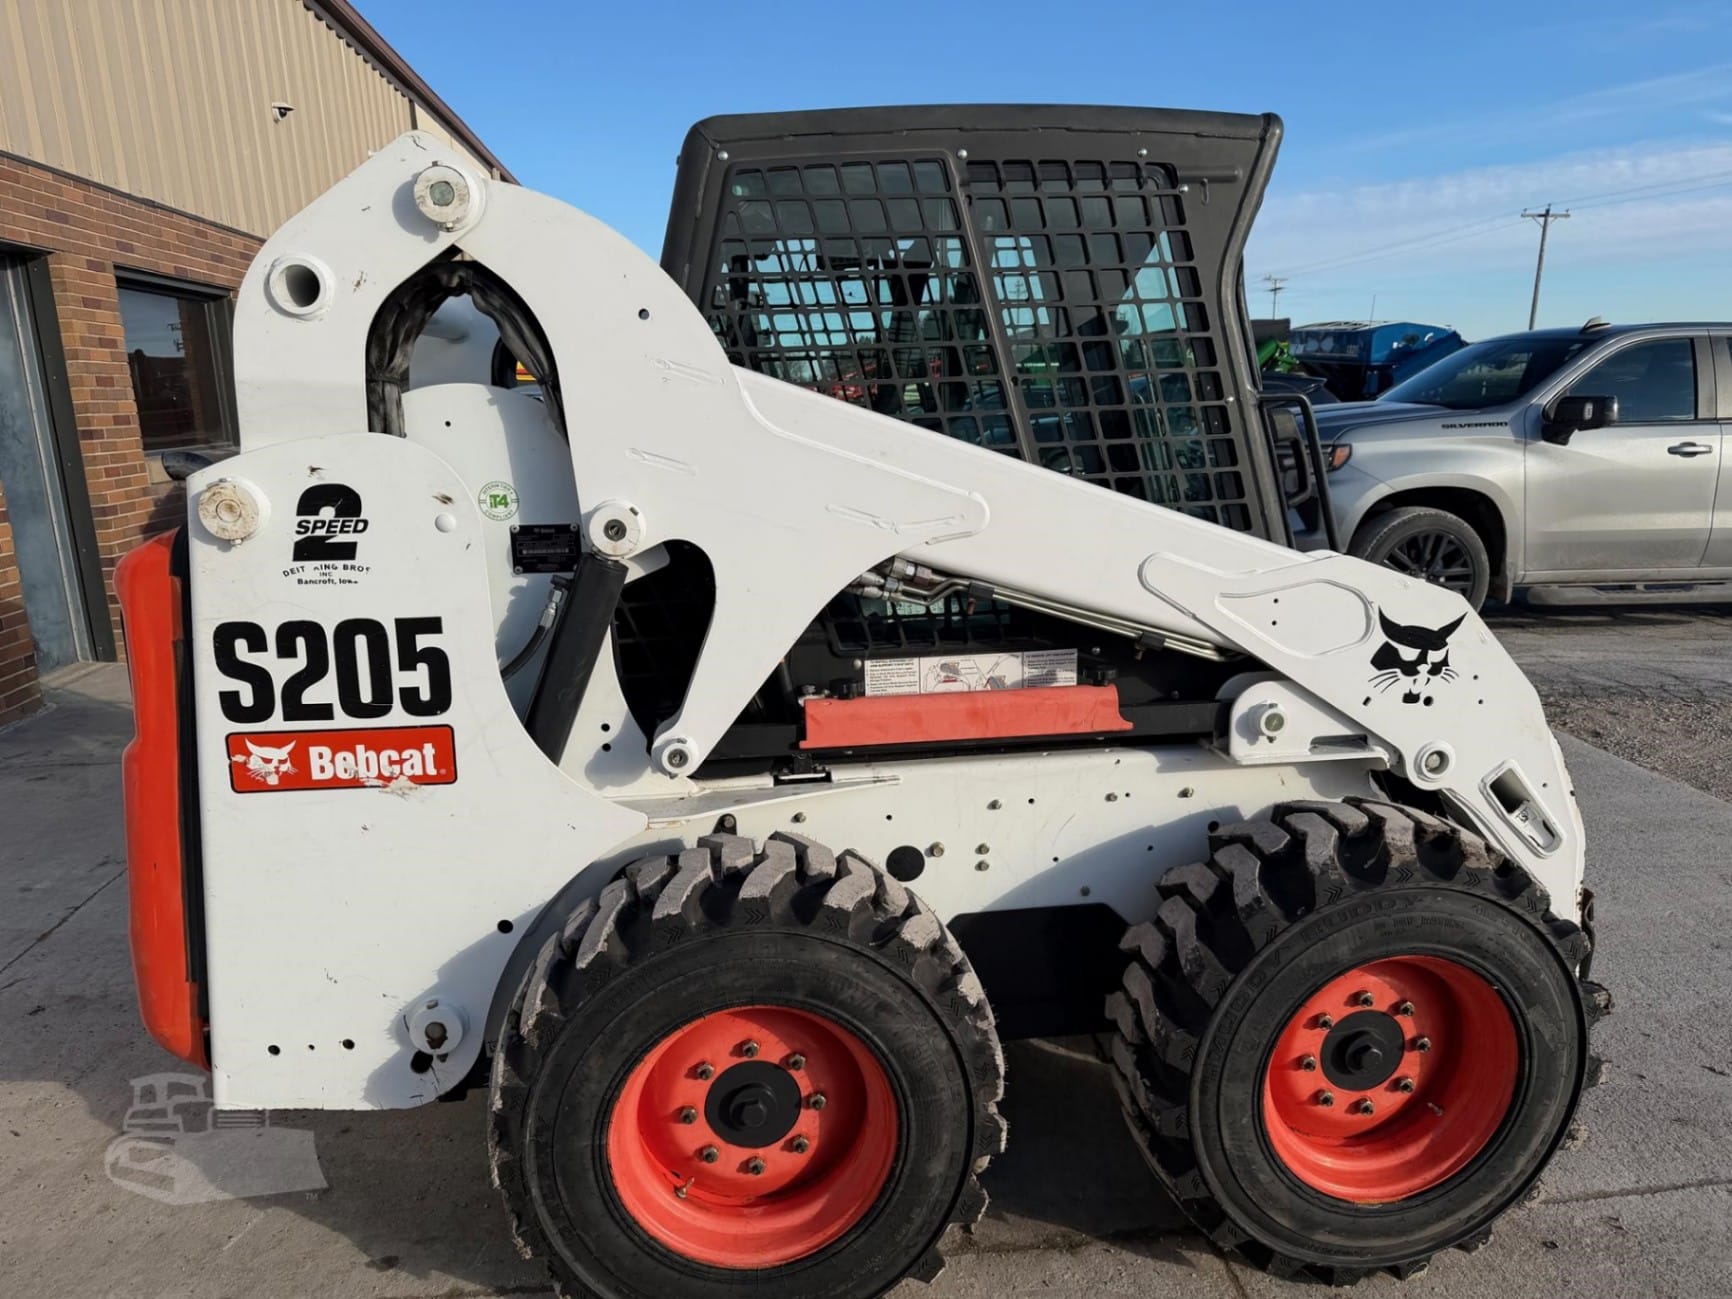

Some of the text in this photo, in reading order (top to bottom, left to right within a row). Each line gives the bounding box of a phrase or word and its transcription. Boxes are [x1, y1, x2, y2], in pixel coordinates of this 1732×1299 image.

[1441, 421, 1508, 429] SILVERADO
[292, 483, 363, 562] 2
[295, 518, 369, 535] SPEED
[213, 616, 452, 724] S205
[308, 742, 437, 781] Bobcat
